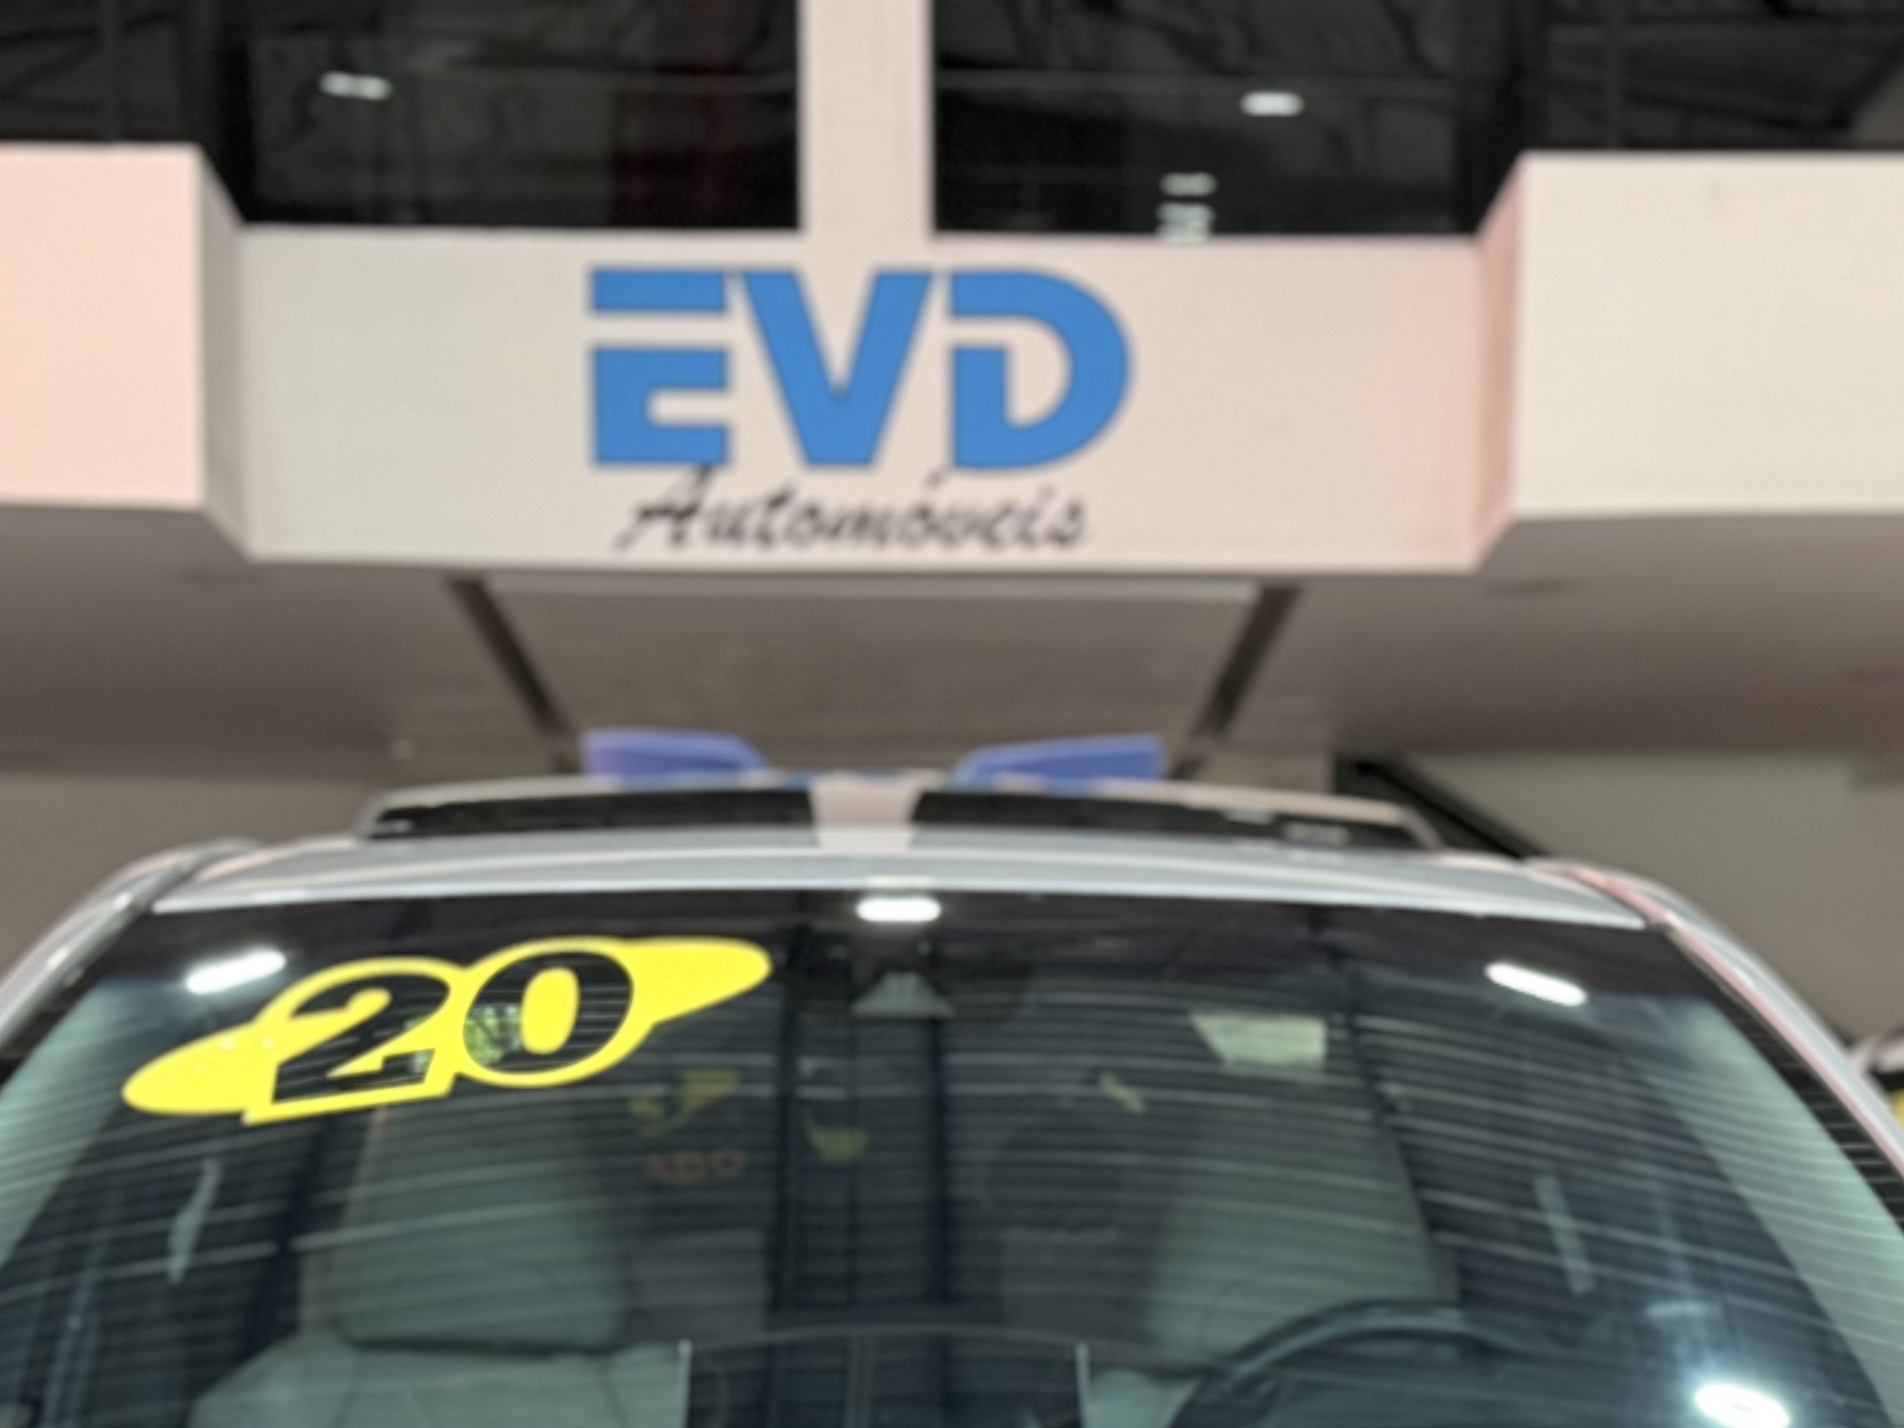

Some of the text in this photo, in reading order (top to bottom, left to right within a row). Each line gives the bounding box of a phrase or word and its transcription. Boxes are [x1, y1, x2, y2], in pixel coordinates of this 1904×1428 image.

[588, 266, 1134, 474] EVD
[613, 464, 1087, 555] Automóveis
[270, 950, 635, 1104] 20
